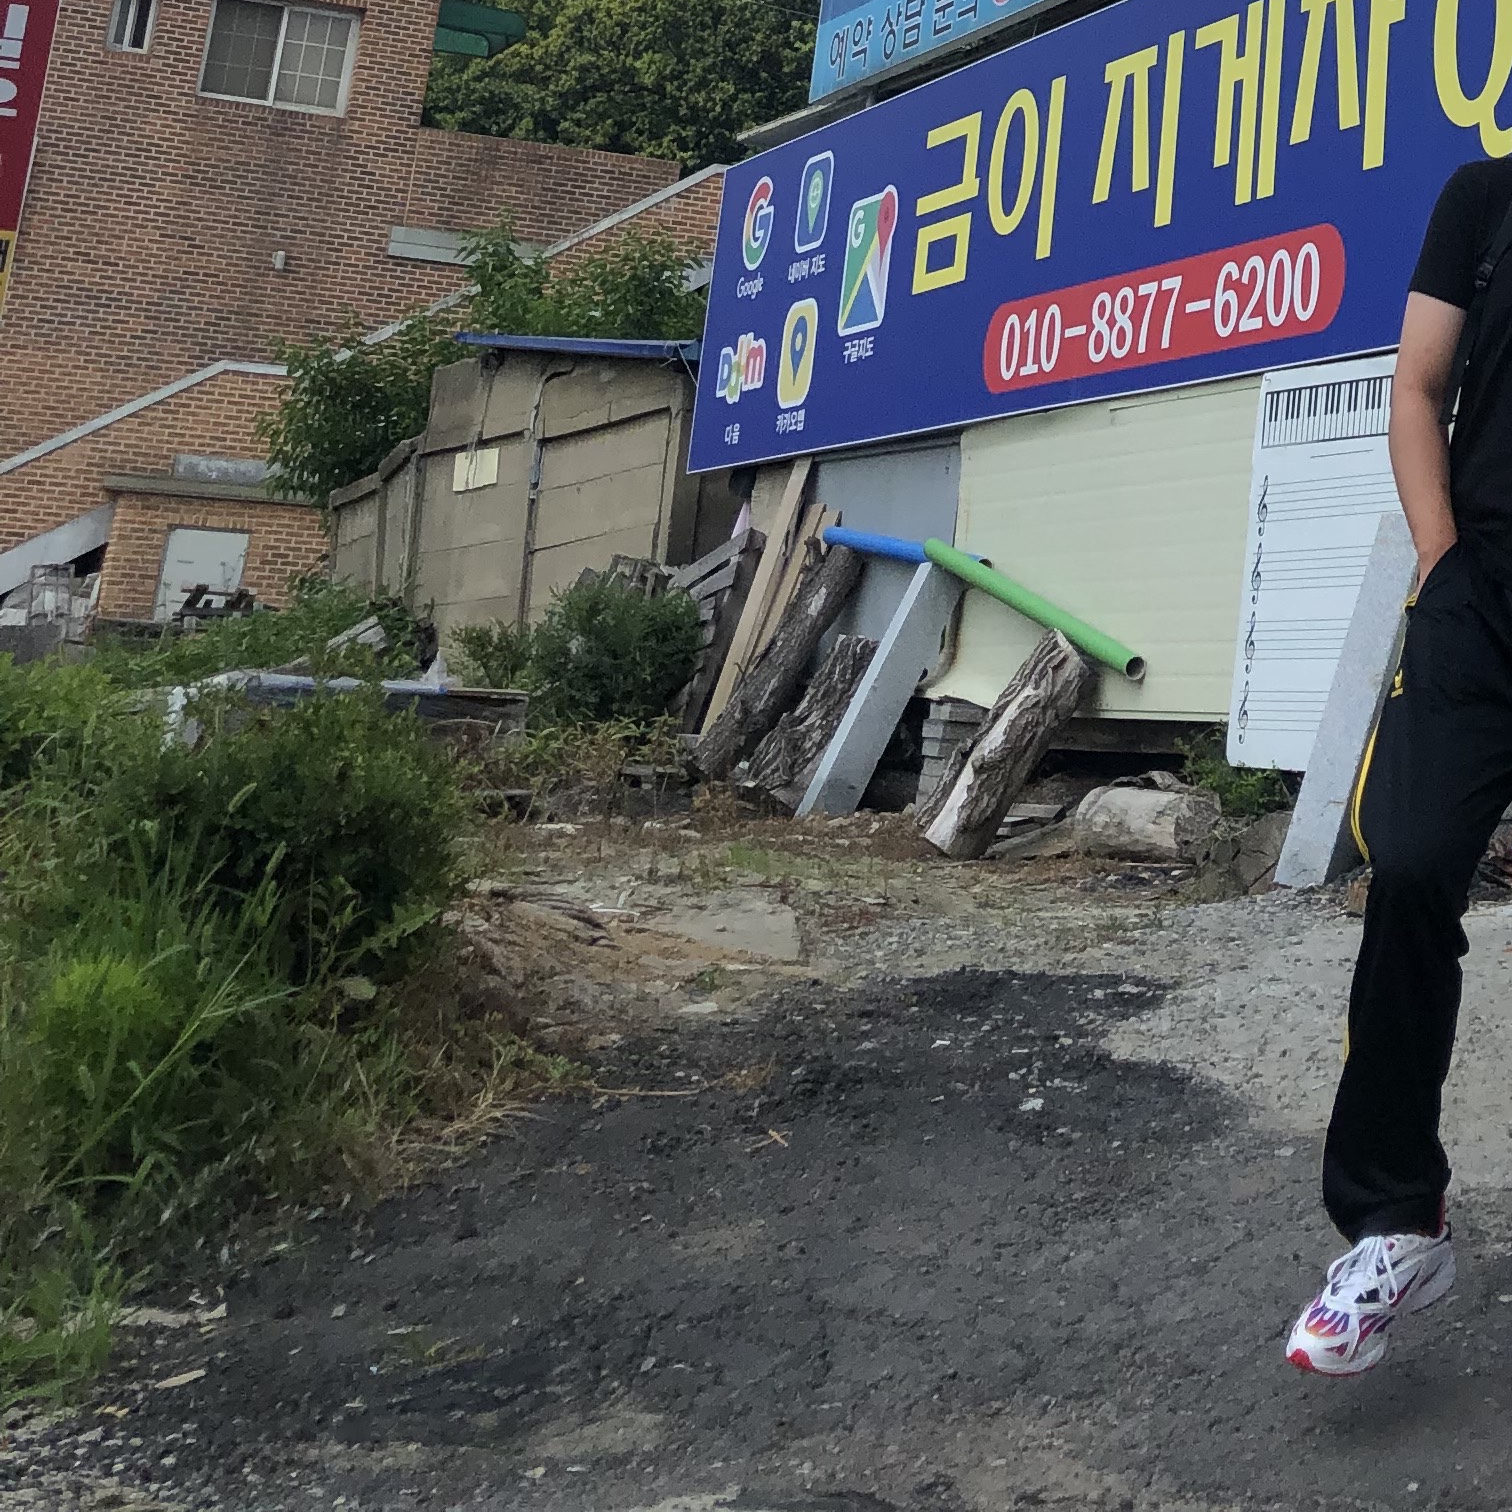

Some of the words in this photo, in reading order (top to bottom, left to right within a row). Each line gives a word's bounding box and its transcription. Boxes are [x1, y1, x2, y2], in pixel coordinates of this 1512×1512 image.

[829, 15, 874, 80] 예약
[912, 75, 1067, 295] 금이
[810, 254, 826, 275] 지도
[736, 272, 764, 299] Google
[1000, 242, 1319, 380] 010-8877-6200
[843, 336, 875, 364] 구글지도
[725, 423, 741, 445] 다음
[776, 409, 806, 435] 카카오맵
